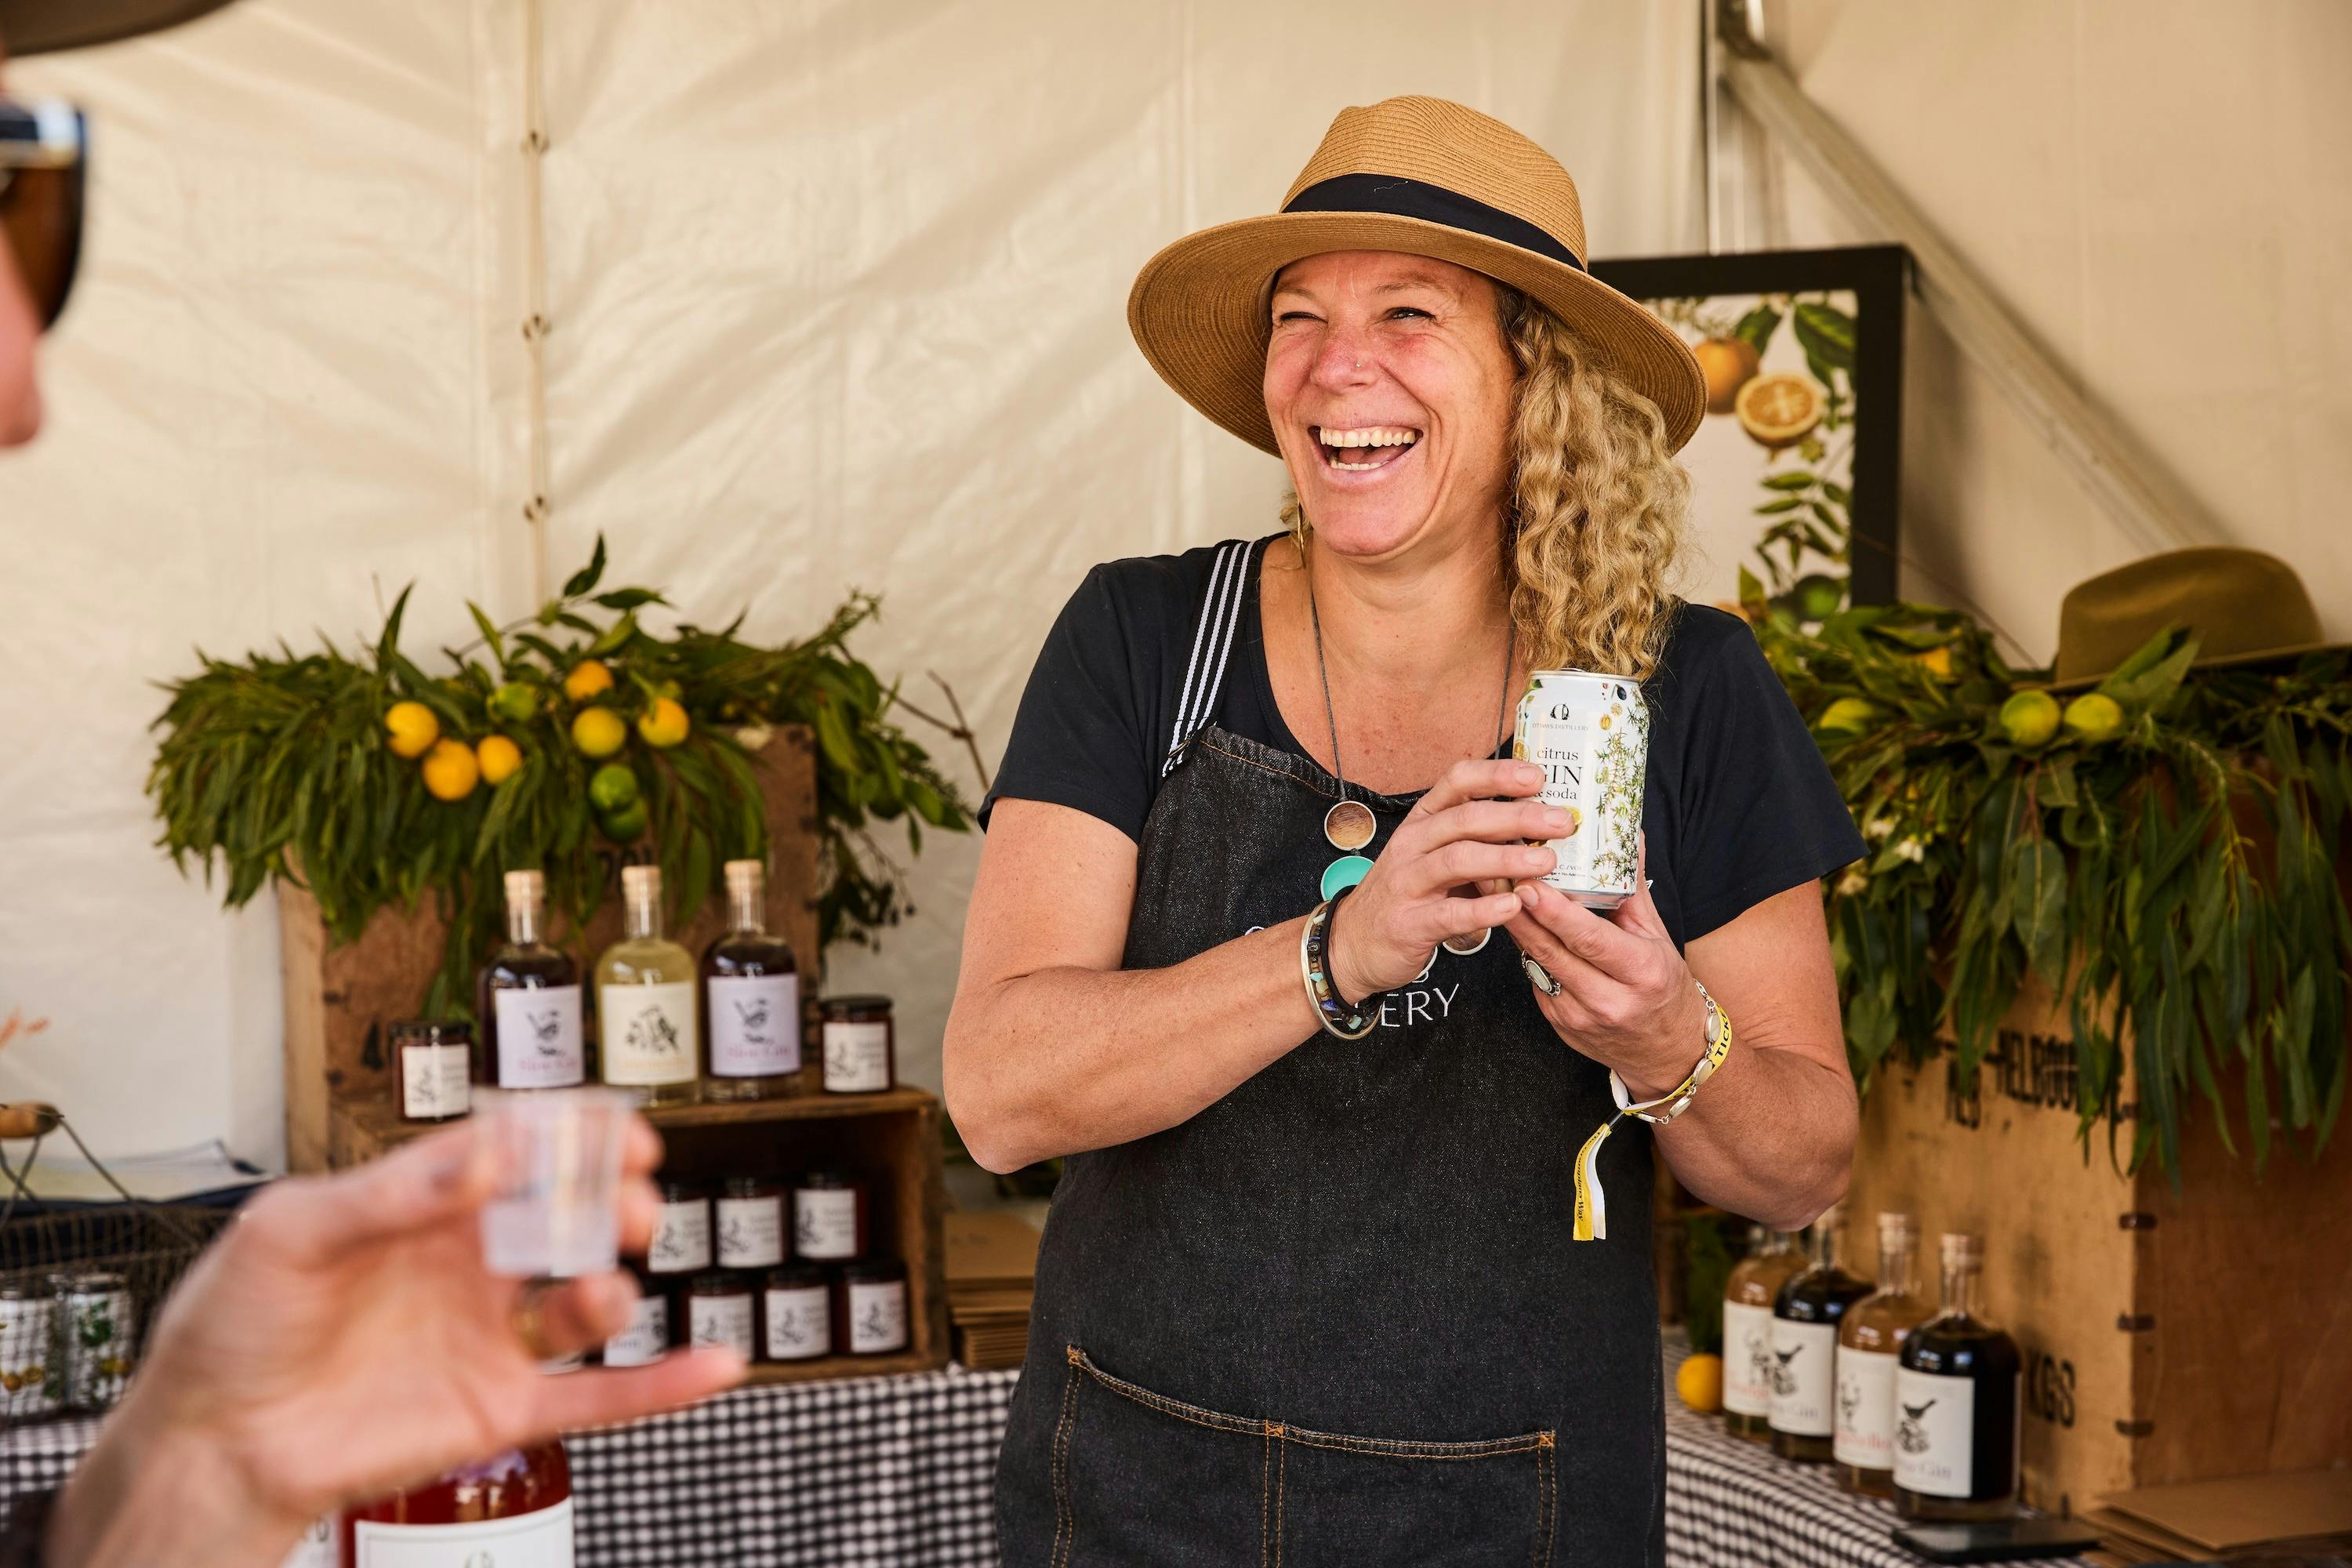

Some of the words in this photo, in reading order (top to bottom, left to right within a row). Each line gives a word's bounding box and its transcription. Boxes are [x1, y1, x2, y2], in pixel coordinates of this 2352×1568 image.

[1537, 746, 1579, 761] citrus
[1546, 787, 1577, 800] soda
[1380, 982, 1460, 1029] ERY
